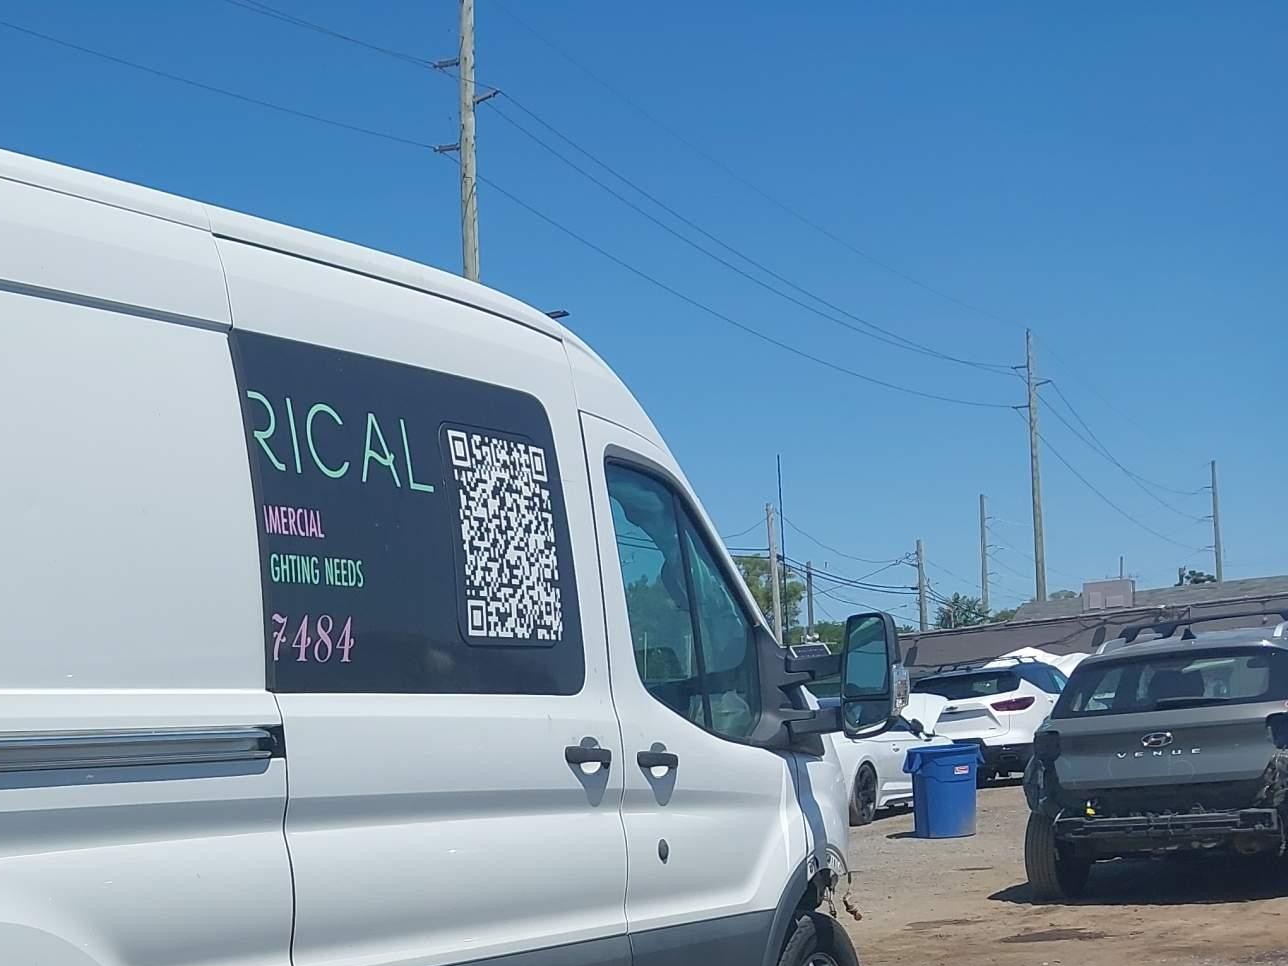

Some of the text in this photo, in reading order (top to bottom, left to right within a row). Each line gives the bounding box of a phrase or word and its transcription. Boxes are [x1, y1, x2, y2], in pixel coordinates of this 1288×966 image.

[246, 389, 435, 494] RICAL
[270, 553, 364, 588] GHTING NEEDS
[271, 613, 355, 663] 7484
[1116, 747, 1201, 759] VENUE
